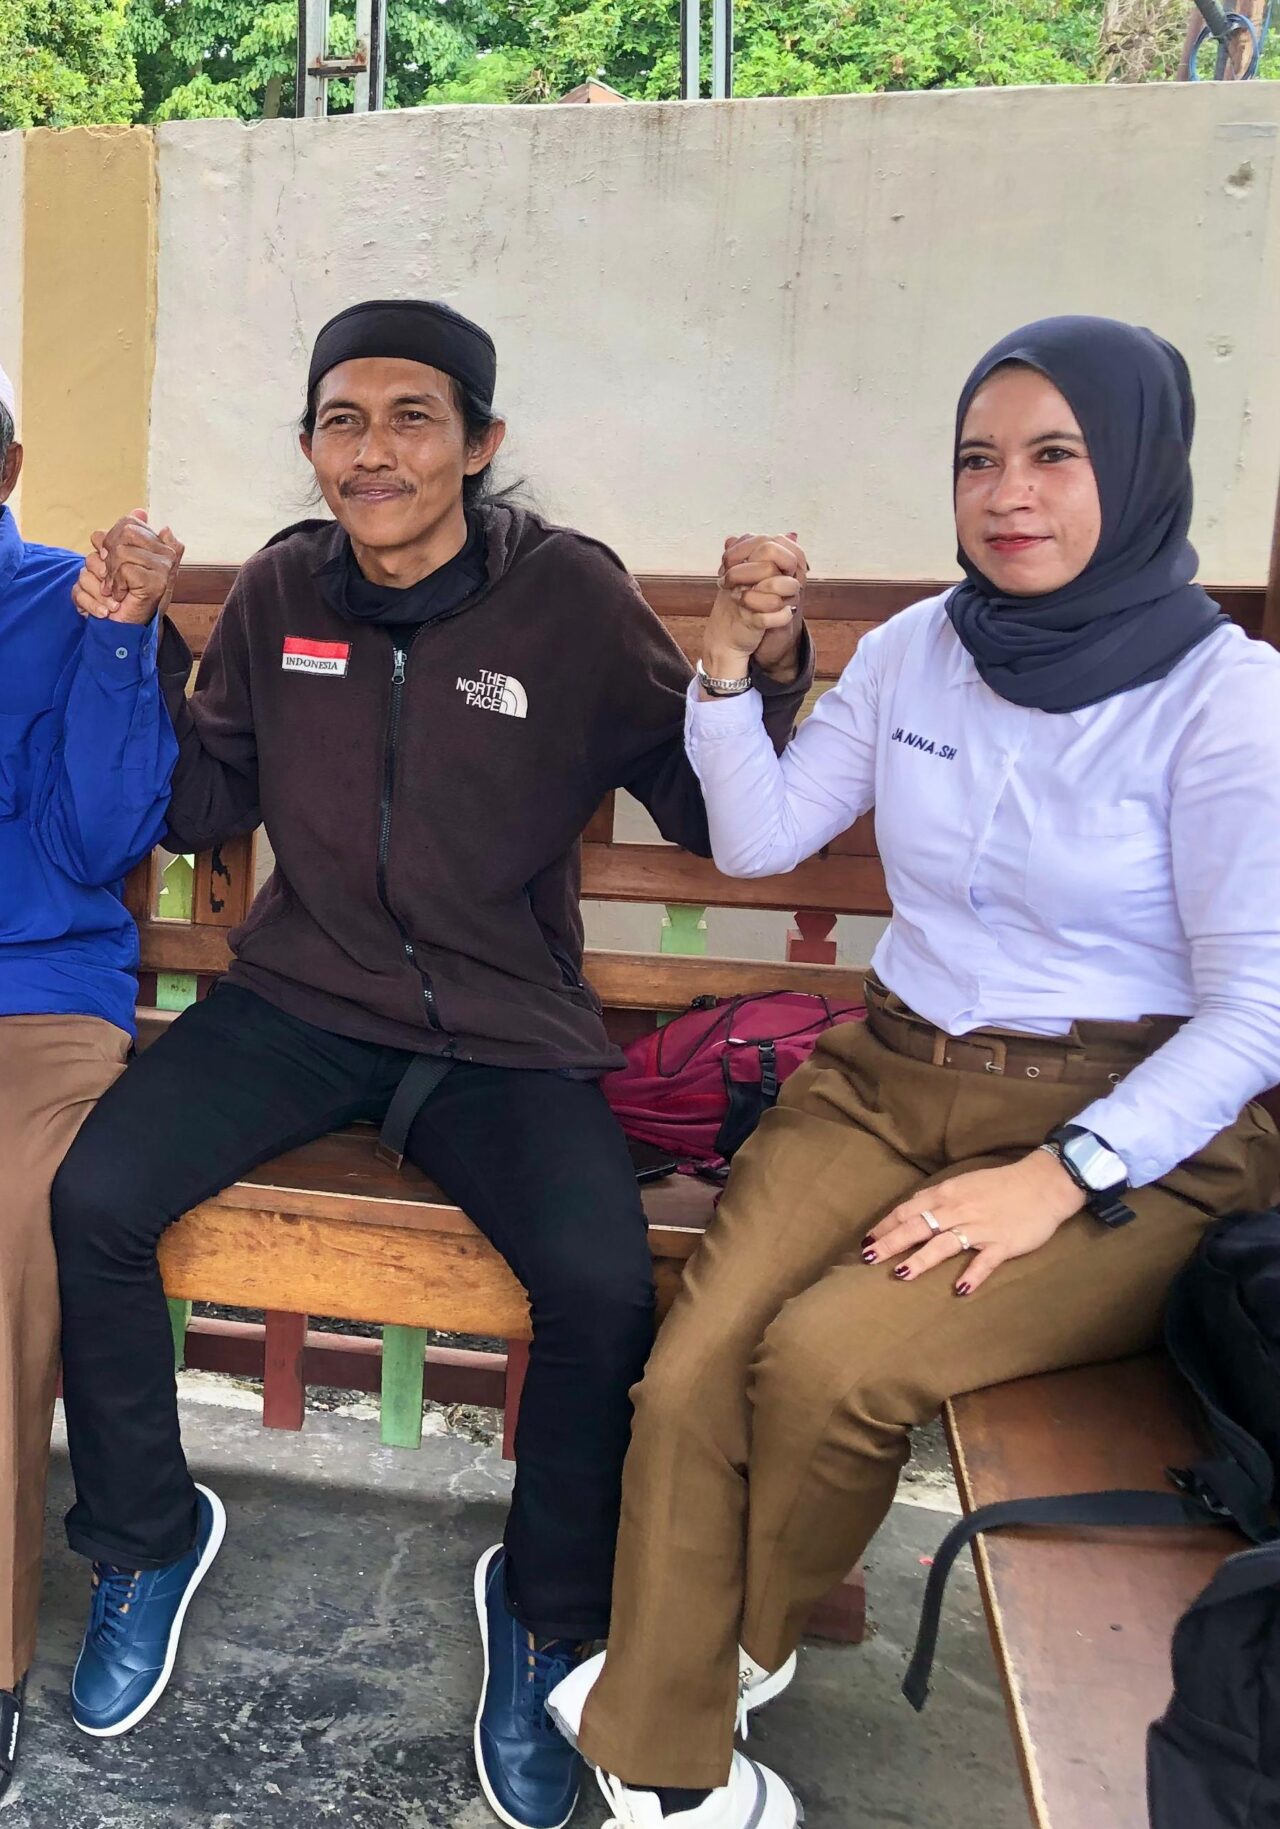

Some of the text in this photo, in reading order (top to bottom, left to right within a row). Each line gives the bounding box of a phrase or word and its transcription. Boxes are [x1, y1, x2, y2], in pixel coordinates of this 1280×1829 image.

[285, 656, 338, 670] INDONESIA
[478, 668, 507, 687] THE
[455, 676, 504, 700] NORTH
[465, 692, 502, 712] FACE
